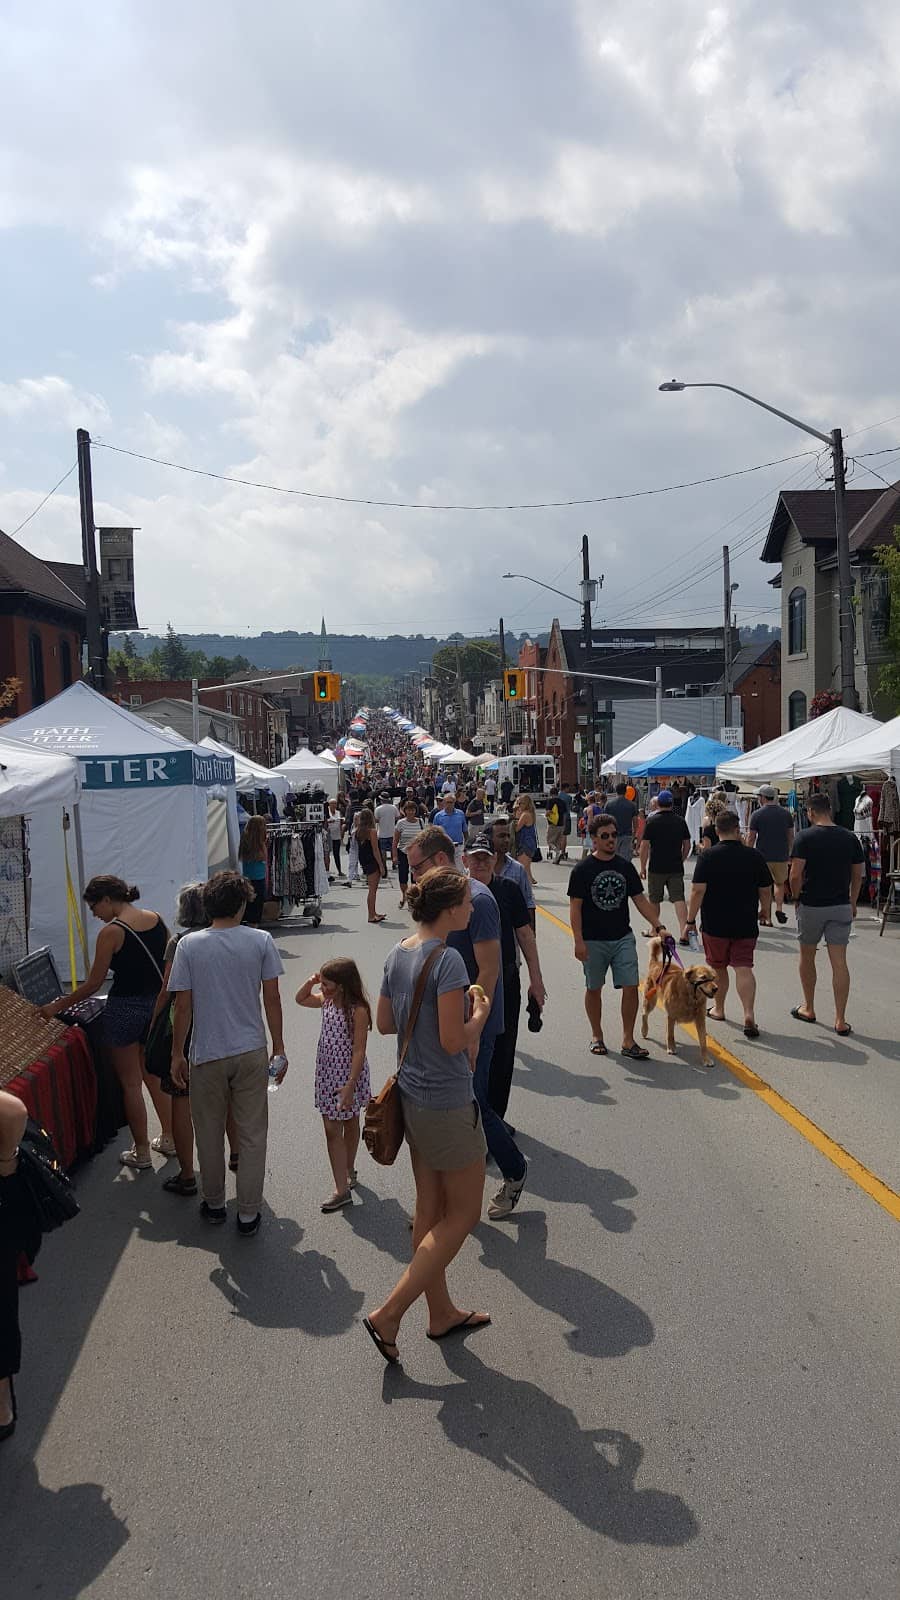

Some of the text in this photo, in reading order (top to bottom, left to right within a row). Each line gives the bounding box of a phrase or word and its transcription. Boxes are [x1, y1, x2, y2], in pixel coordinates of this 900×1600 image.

[33, 727, 90, 736] BATH
[195, 758, 233, 781] BATH FITTER
